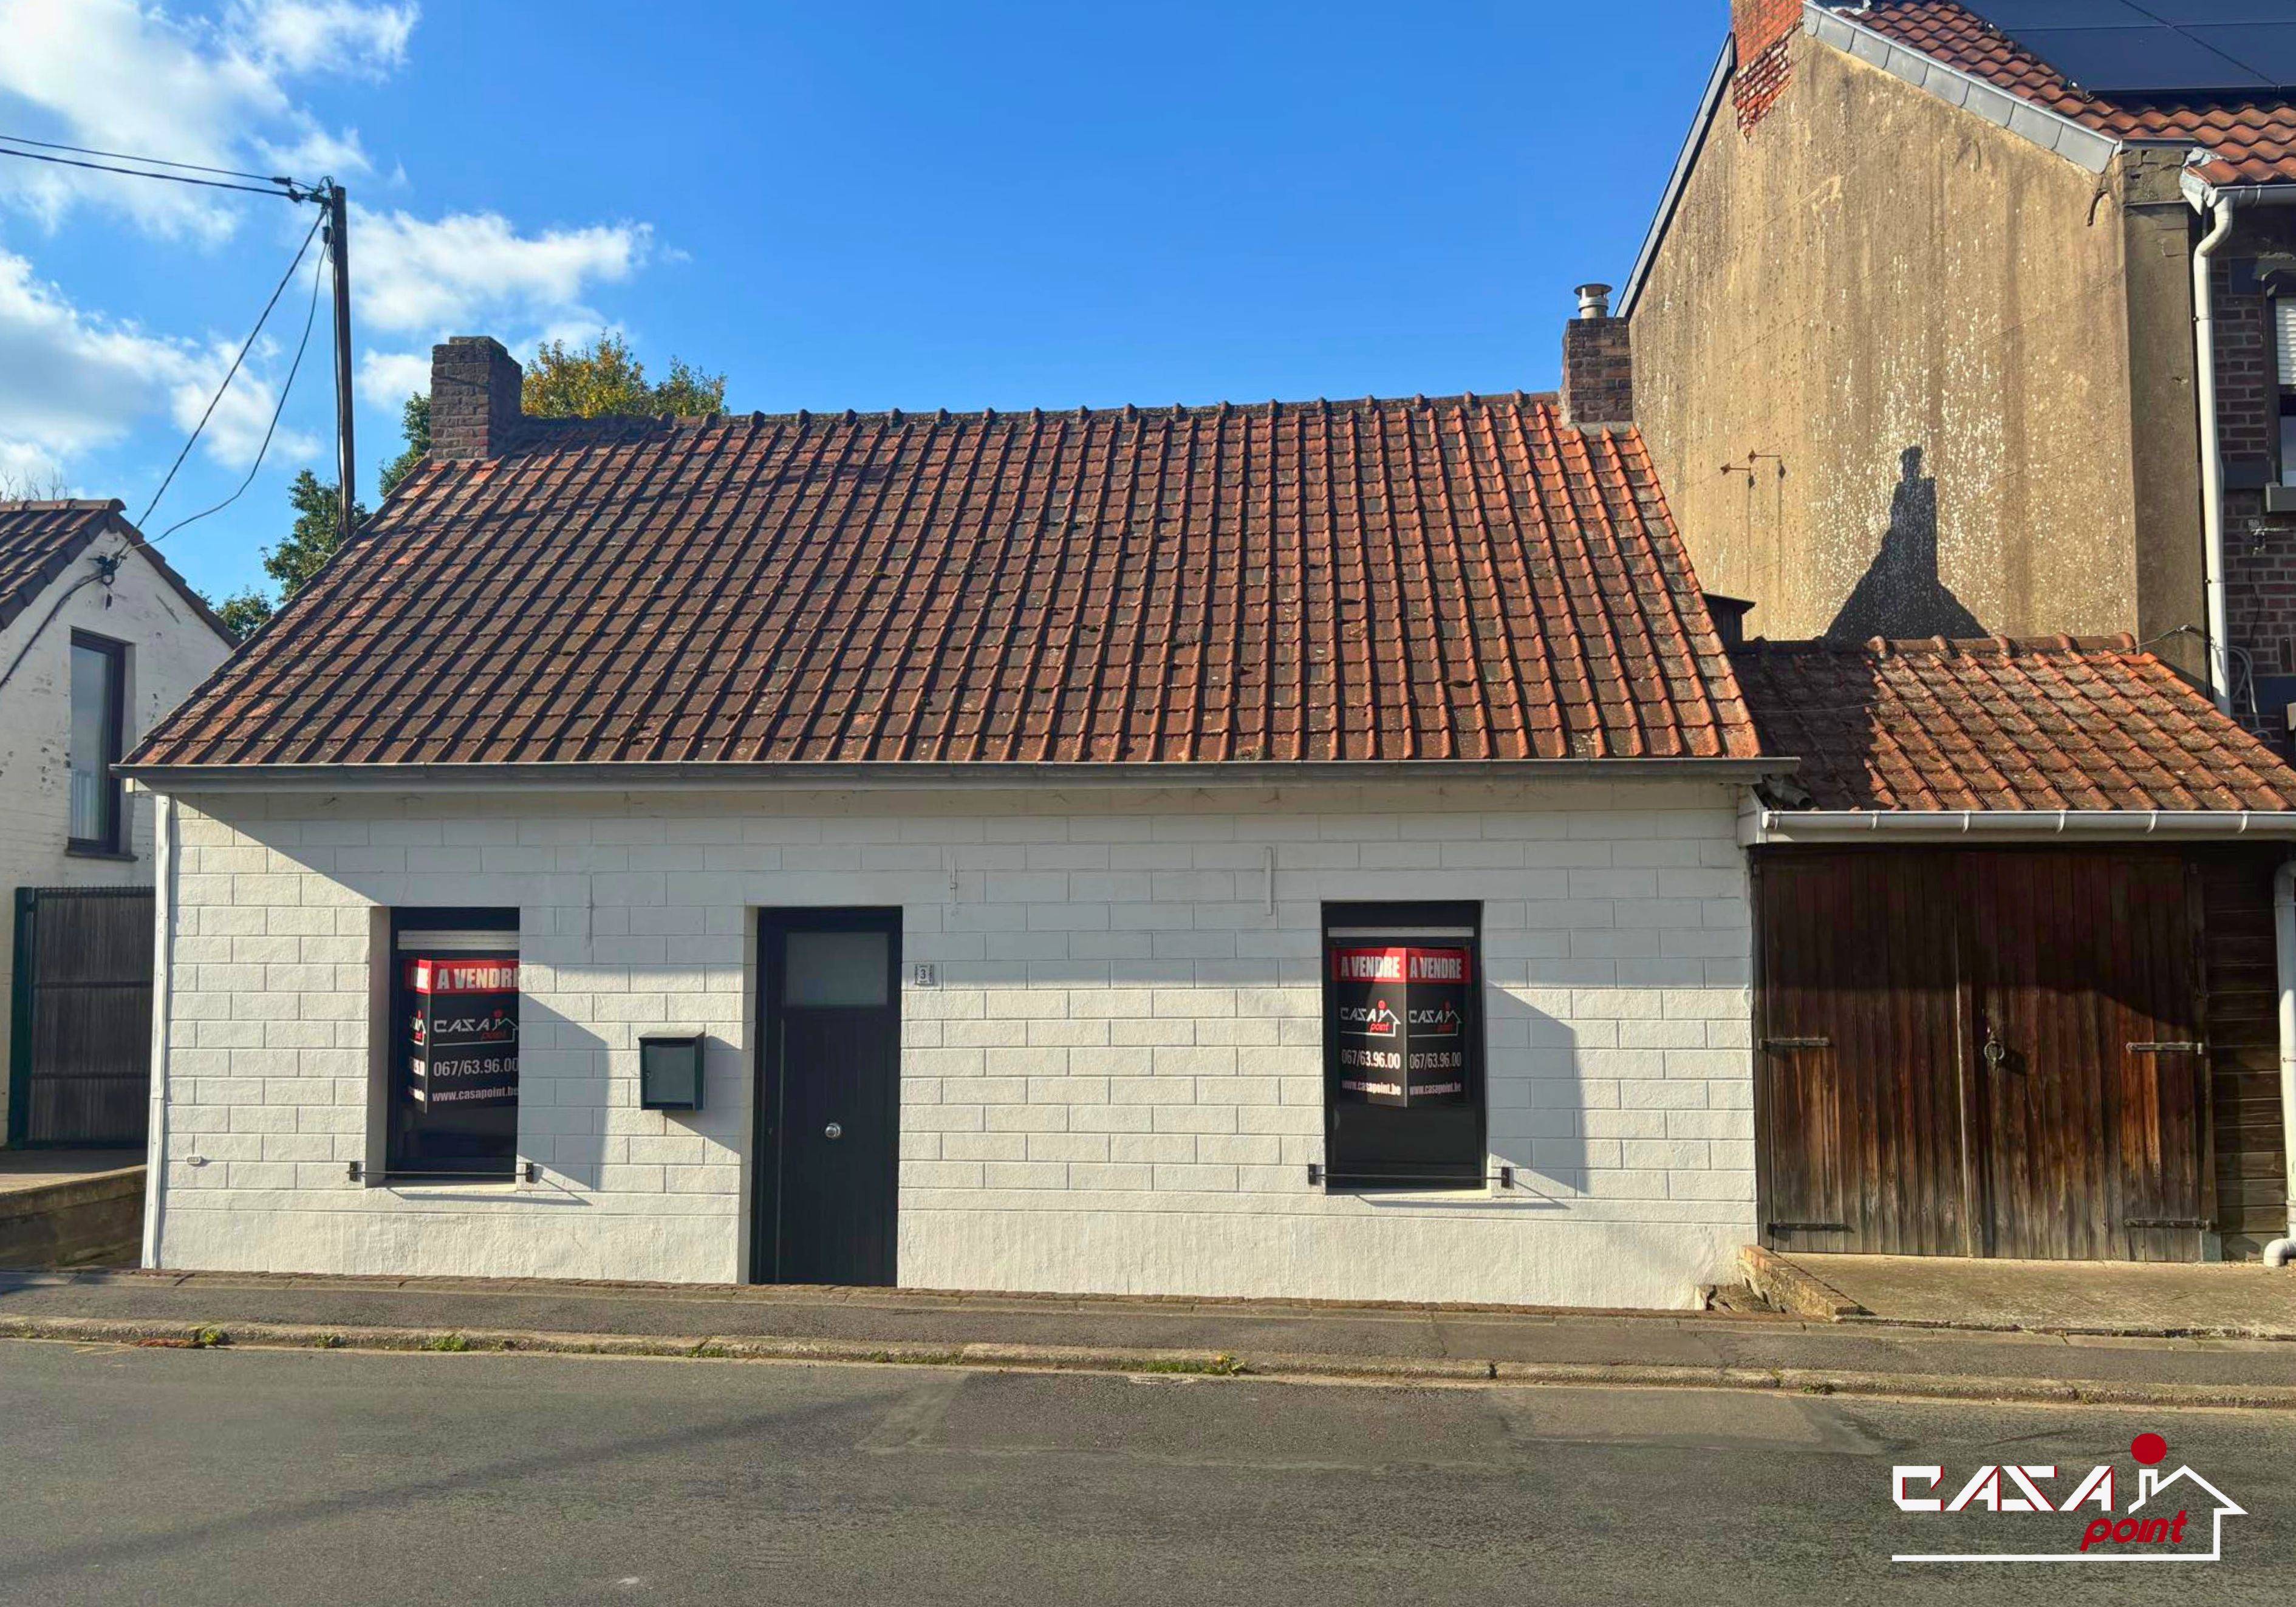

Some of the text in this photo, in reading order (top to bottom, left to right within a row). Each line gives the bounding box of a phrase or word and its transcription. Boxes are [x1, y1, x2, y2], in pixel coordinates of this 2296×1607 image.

[1341, 956, 1400, 978] A VENDRE
[1410, 957, 1461, 979] A VENDRE
[437, 968, 450, 990] A
[1340, 1008, 1376, 1022] CASA
[1409, 1010, 1443, 1023] CASA
[434, 1018, 490, 1032] CASA
[433, 1057, 519, 1077] 067/63.96.00
[1341, 1049, 1401, 1069] 067/63.96.00
[1409, 1052, 1461, 1070] 067/63.96.00
[1341, 1080, 1401, 1096] www.casapoint.be
